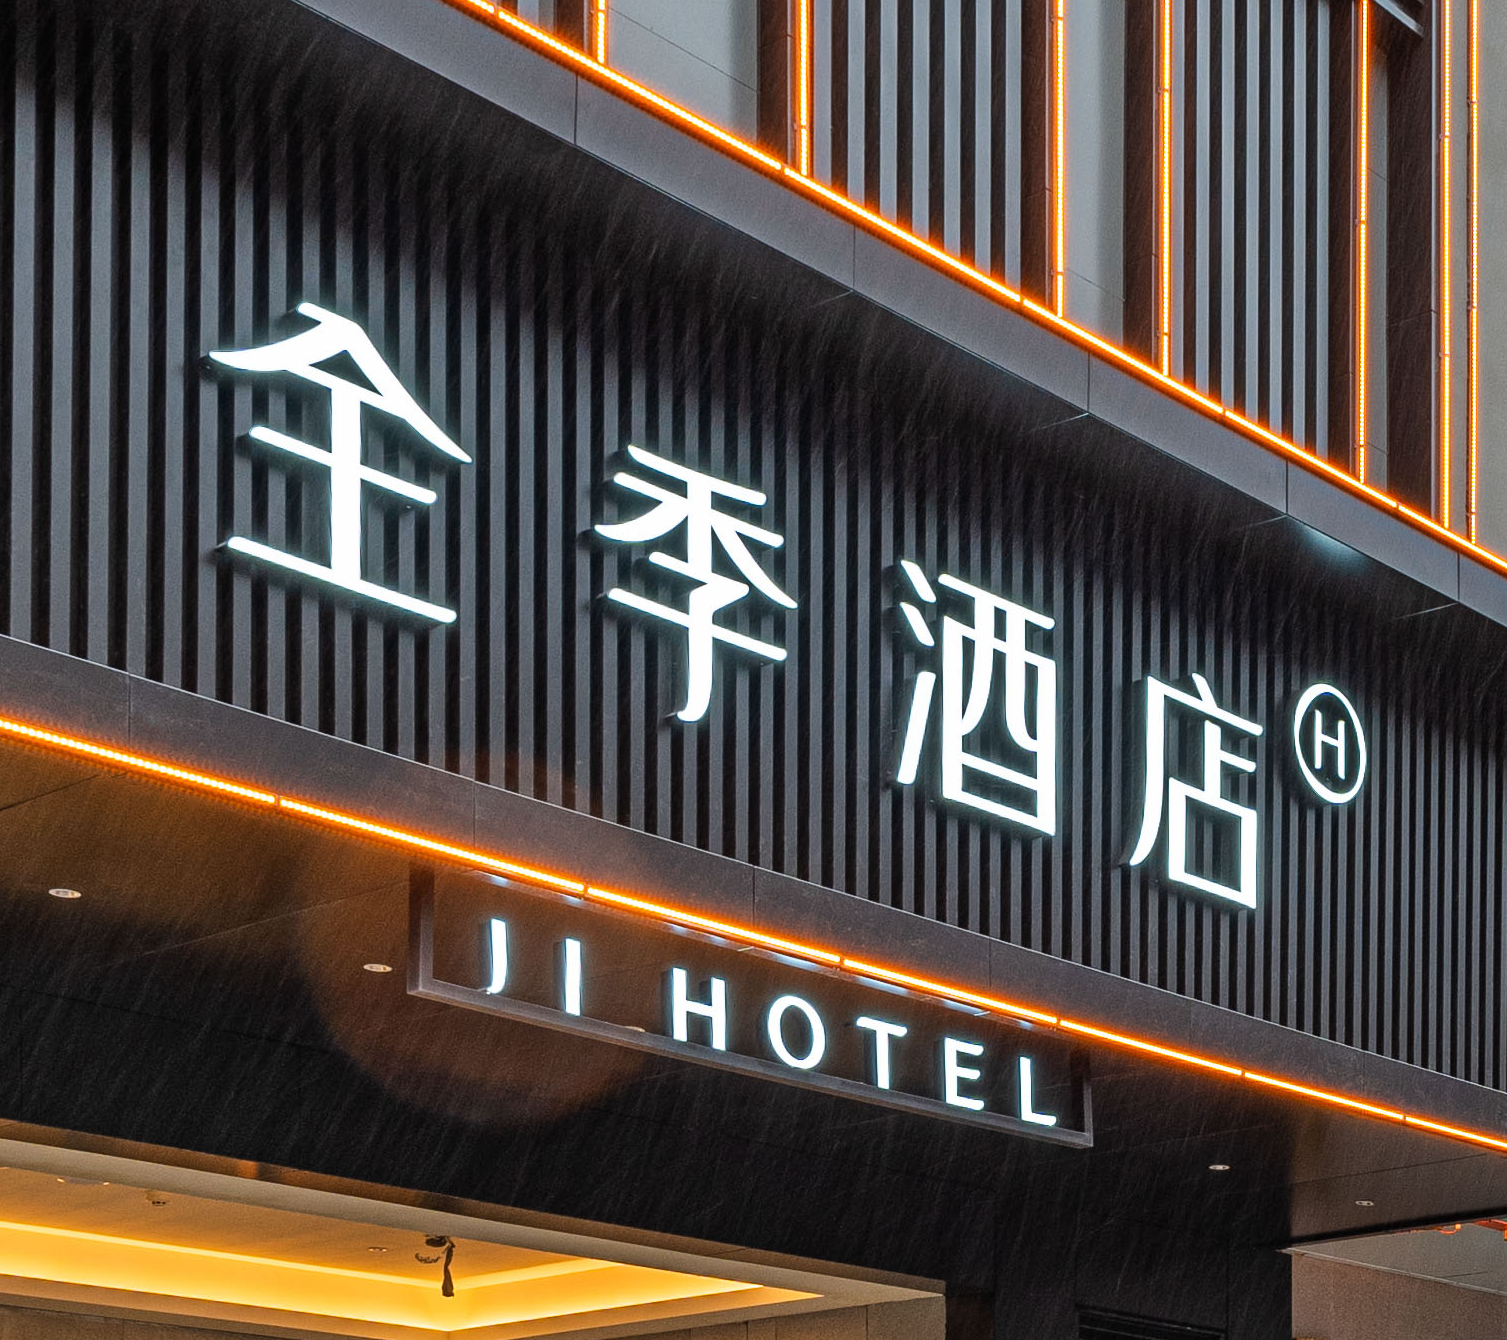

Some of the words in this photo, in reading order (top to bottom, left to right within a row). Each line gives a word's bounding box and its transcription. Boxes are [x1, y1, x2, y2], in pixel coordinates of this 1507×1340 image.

[207, 301, 1264, 910] 全季酒店
[486, 917, 583, 1017] JI
[669, 966, 1057, 1127] HOTEL
